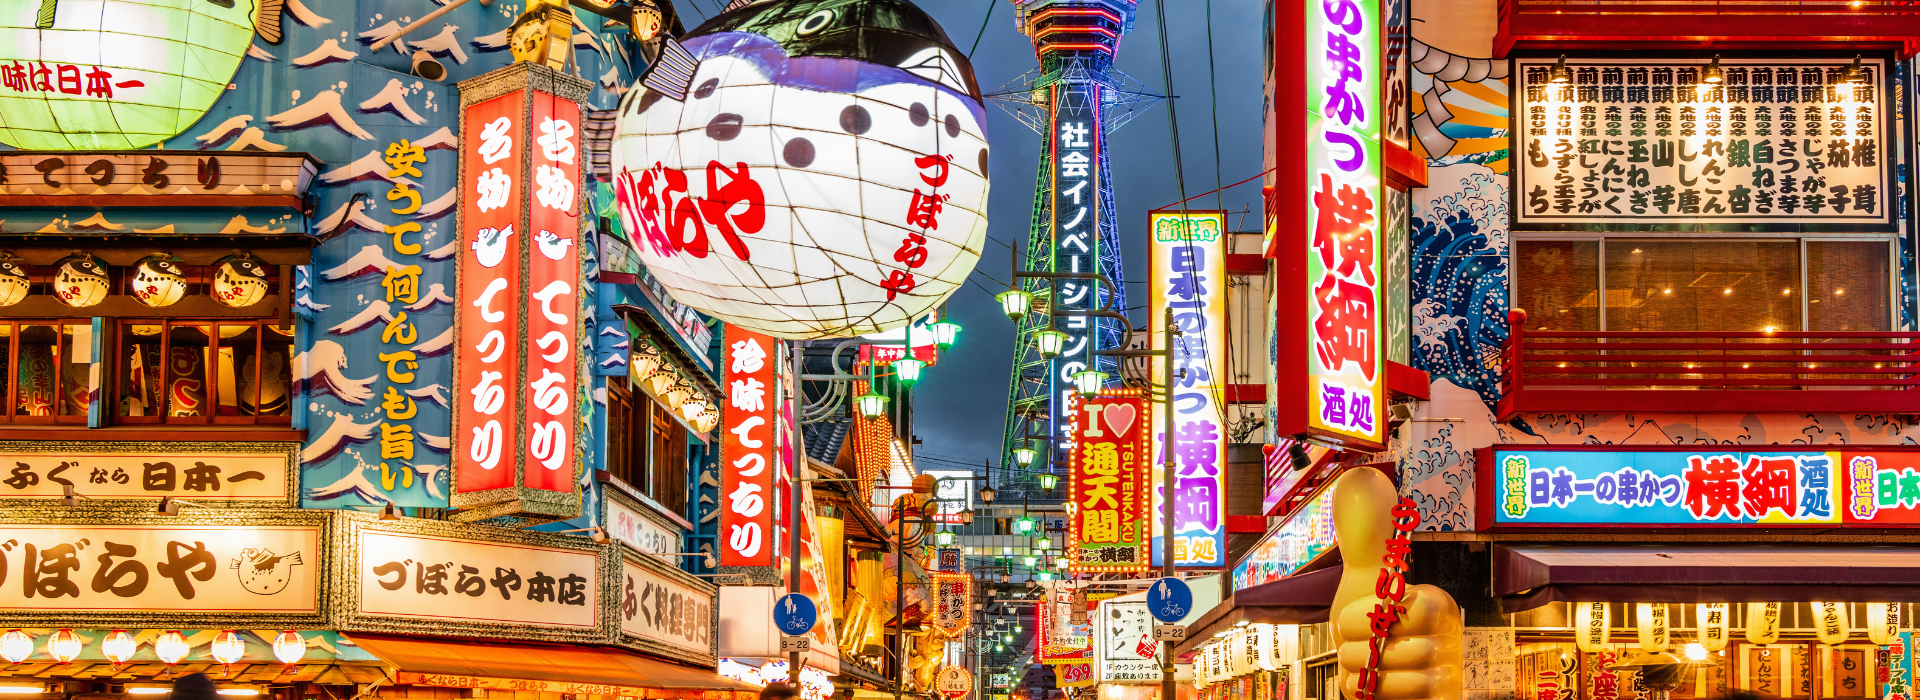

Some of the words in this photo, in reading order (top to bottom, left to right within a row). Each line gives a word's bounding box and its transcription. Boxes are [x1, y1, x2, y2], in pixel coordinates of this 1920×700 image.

[0, 60, 145, 98] 味は日本一
[1527, 67, 1549, 103] 前頭
[1577, 67, 1599, 103] 前頭
[1602, 67, 1624, 103] 前頭
[1627, 67, 1649, 103] 前頭
[1652, 67, 1674, 103] 前頭
[1676, 67, 1698, 103] 前頭
[1726, 67, 1749, 103] 前頭
[1751, 67, 1773, 103] 前頭
[1776, 67, 1798, 103] 前頭
[1801, 67, 1824, 103] 前頭
[1530, 106, 1547, 137] 変わり種
[1556, 106, 1572, 137] 変わり種
[1580, 106, 1597, 137] 変わり種
[1605, 106, 1622, 137] 大地の幸
[1630, 106, 1647, 137] 大地の幸
[1655, 106, 1672, 137] 大地の幸
[1680, 106, 1697, 137] 大地の幸
[1705, 106, 1722, 137] 大地の幸
[1730, 106, 1747, 137] 大地の幸
[1754, 106, 1772, 137] 大地の幸
[1779, 106, 1797, 137] 大地の幸
[1804, 106, 1822, 137] 大地の幸
[1829, 106, 1847, 137] 大地の幸
[1855, 106, 1872, 137] 大地の幸
[1528, 139, 1549, 214] もち
[1552, 139, 1578, 214] うずら玉子
[1577, 139, 1601, 214] 紅しょうが
[1602, 139, 1625, 214] にんにく
[1627, 139, 1651, 214] 玉ねぎ
[1652, 139, 1675, 214] 山芋
[1677, 139, 1701, 214] しし唐
[1702, 139, 1726, 214] れんこん
[1726, 139, 1751, 214] 銀杏
[1752, 139, 1777, 214] 白ねぎ
[1777, 139, 1800, 214] さつま芋
[1802, 139, 1826, 214] じゃが芋
[1827, 139, 1851, 214] 茄子
[1851, 139, 1876, 214] 椎茸
[880, 153, 953, 301] づぼらや
[1157, 219, 1219, 242] 新世界
[1314, 173, 1375, 382] 横綱
[1083, 404, 1103, 437] I
[1323, 383, 1372, 431] 酒処
[729, 337, 766, 557] 珍味てっちり
[1082, 442, 1119, 543] 通天閣
[1122, 441, 1135, 542] TSUTENKAKU
[1157, 420, 1219, 531] 横綱
[1506, 458, 1526, 516] 新世界
[1530, 469, 1681, 505] 日本一の串かつ
[1684, 457, 1797, 518] 横綱
[1800, 459, 1830, 517] 酒処
[1852, 459, 1874, 516] 新世界
[1099, 546, 1135, 563] 横綱
[373, 558, 587, 606] づぼらや本店
[951, 581, 965, 619] 串かつ
[622, 573, 709, 646] ふぐ料理専門
[1707, 611, 1721, 639] 寿司
[1842, 657, 1856, 689] もち
